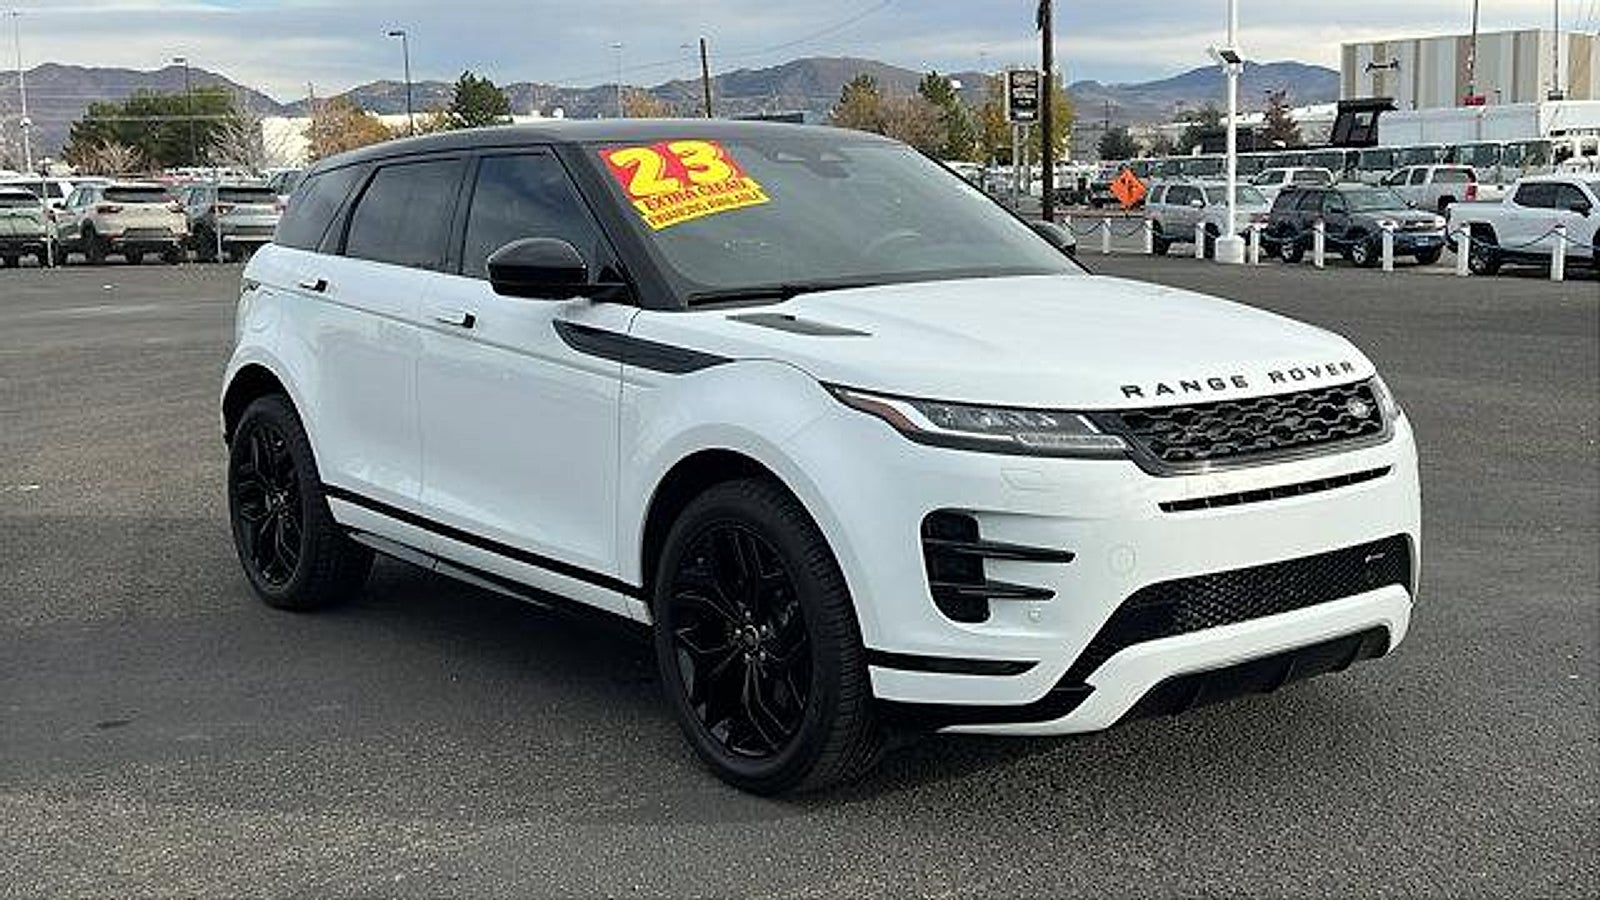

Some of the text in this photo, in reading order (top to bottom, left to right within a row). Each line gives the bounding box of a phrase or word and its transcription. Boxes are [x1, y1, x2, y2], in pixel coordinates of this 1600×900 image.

[609, 140, 733, 196] 23
[643, 189, 698, 212] EXTRA
[1120, 361, 1356, 399] RANGE ROVER
